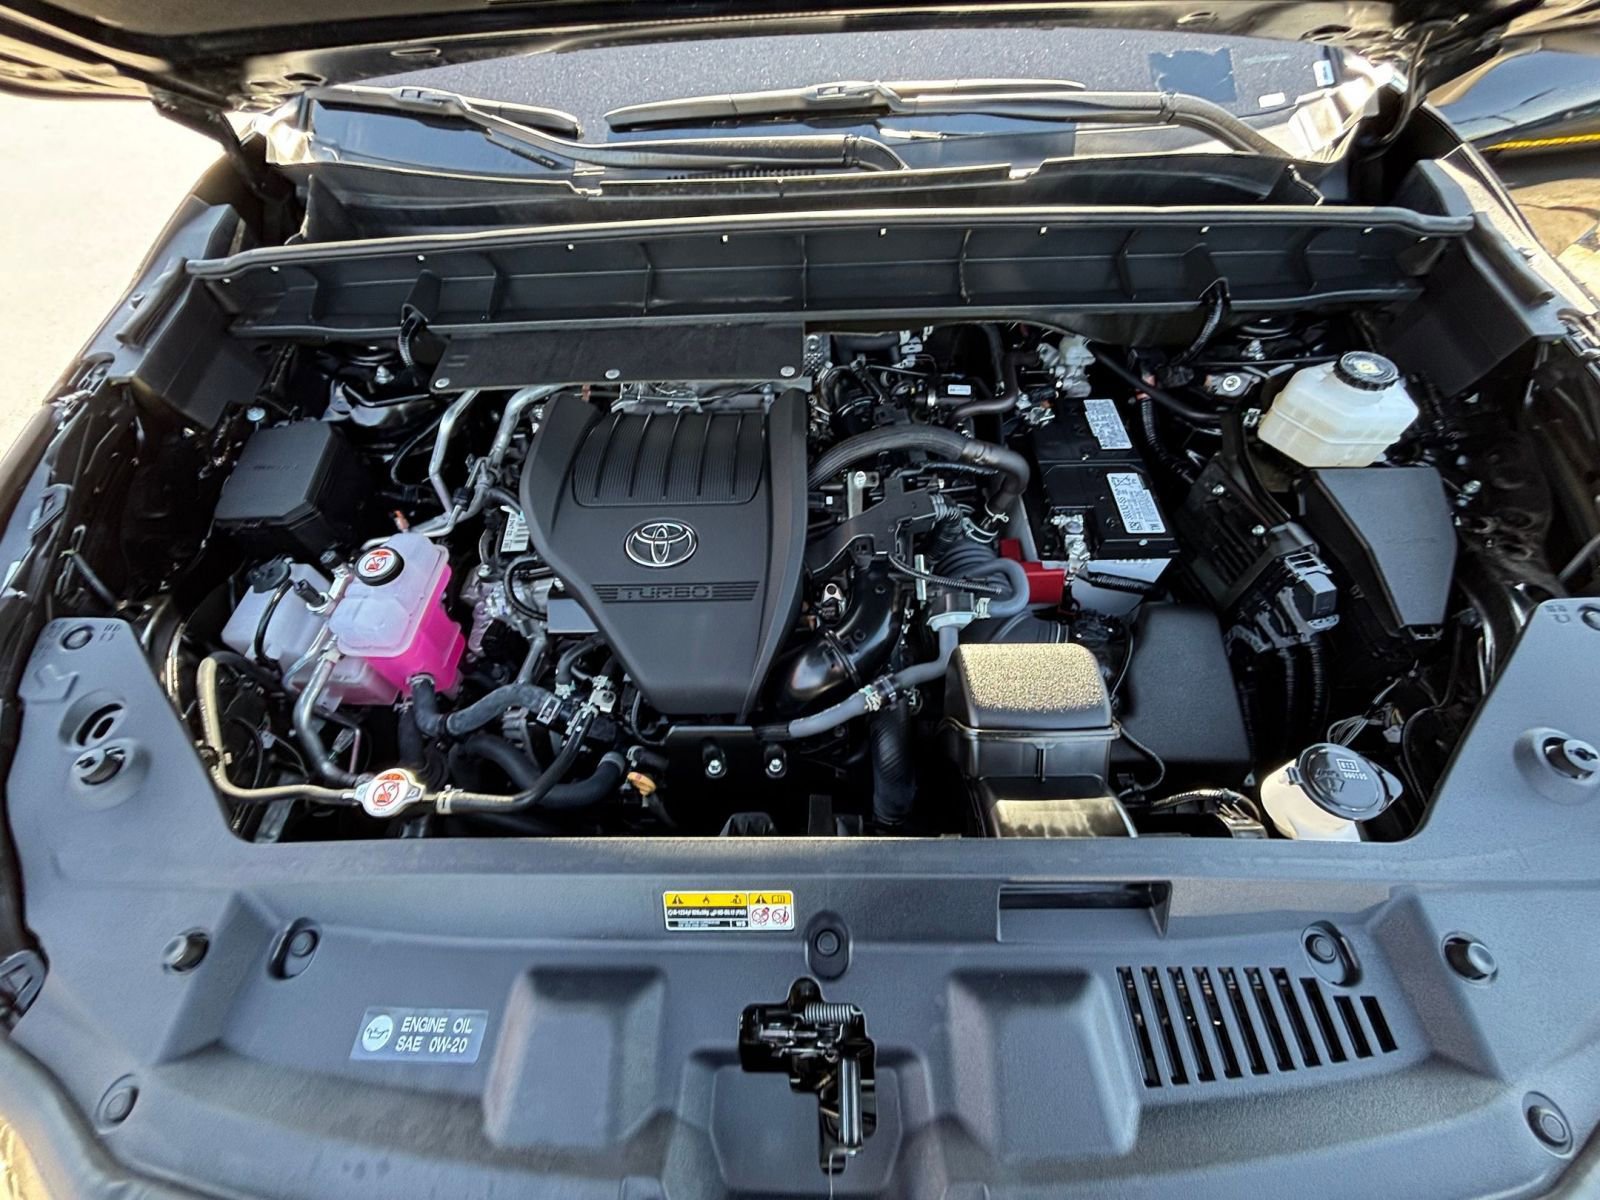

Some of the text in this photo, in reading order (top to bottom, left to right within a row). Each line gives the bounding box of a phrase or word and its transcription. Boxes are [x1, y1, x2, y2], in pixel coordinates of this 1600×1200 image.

[619, 585, 711, 600] TURBO
[400, 1016, 473, 1034] ENGINE OIL
[395, 1035, 468, 1053] SAE 0W-20
